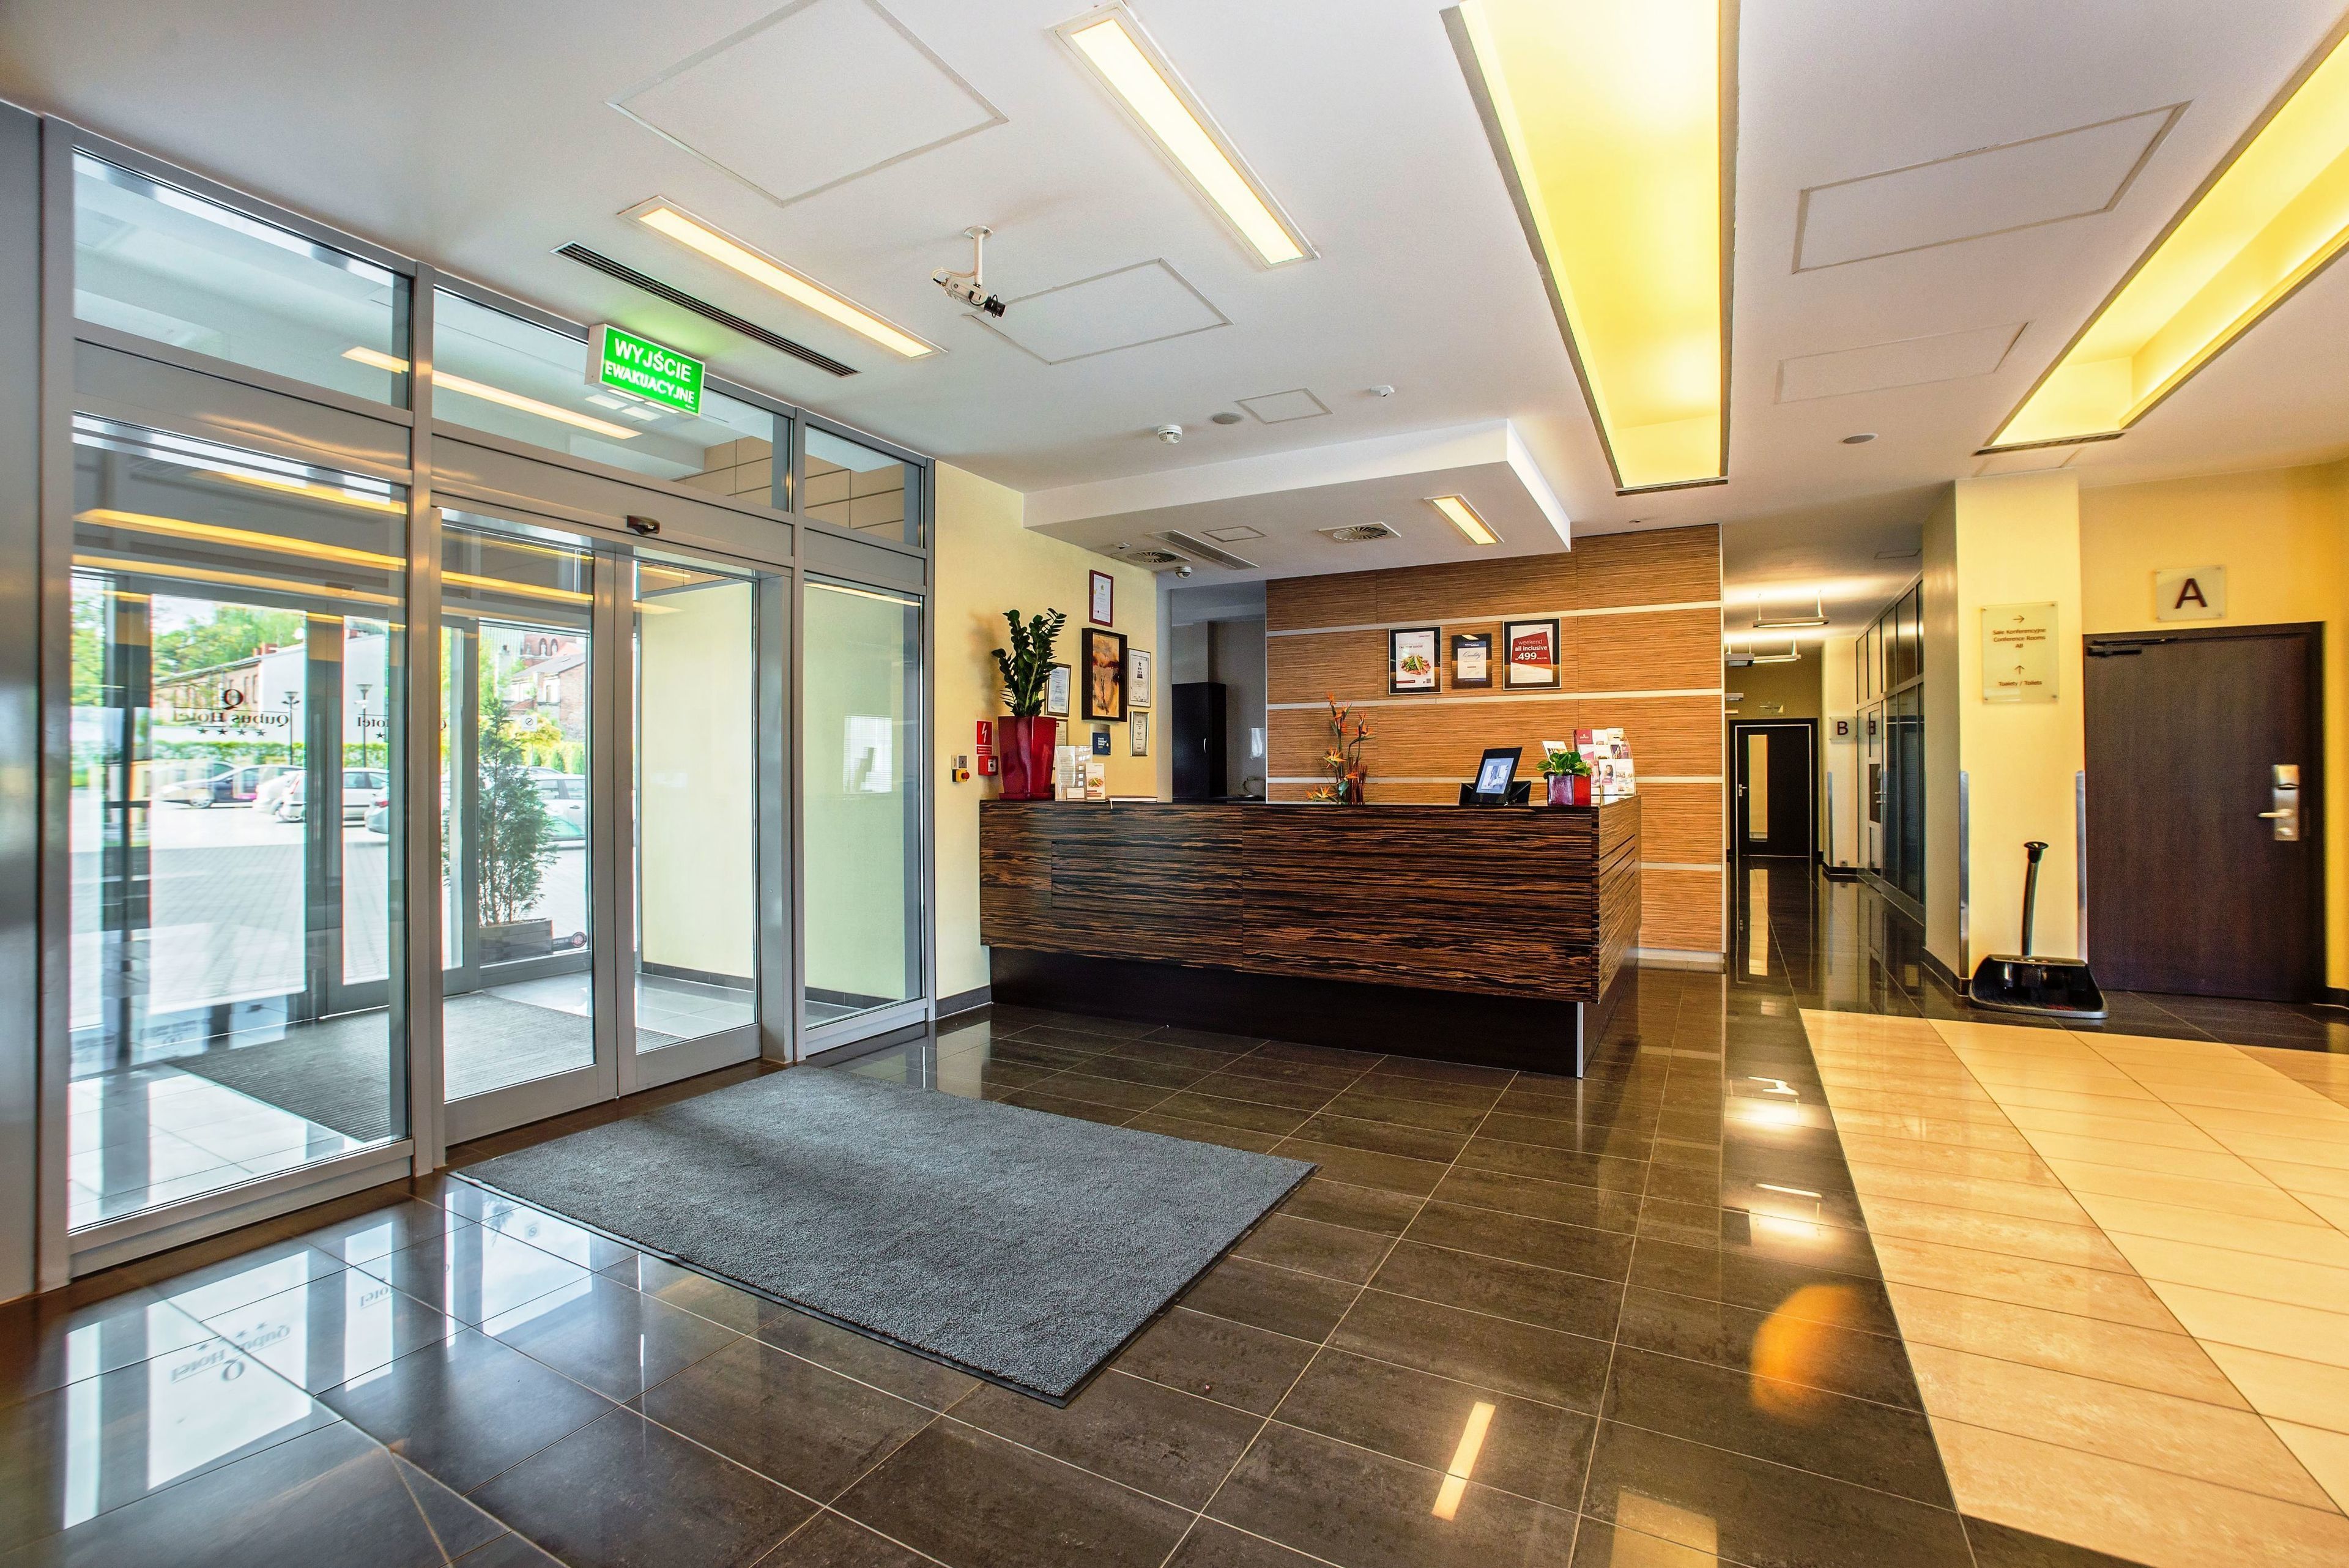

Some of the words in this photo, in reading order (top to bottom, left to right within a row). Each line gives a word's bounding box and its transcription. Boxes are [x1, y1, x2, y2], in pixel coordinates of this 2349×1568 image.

[614, 338, 692, 382] WYJŚCIE
[604, 360, 695, 404] EWAKUACYJNE
[2174, 578, 2208, 609] A
[1837, 721, 1849, 735] B
